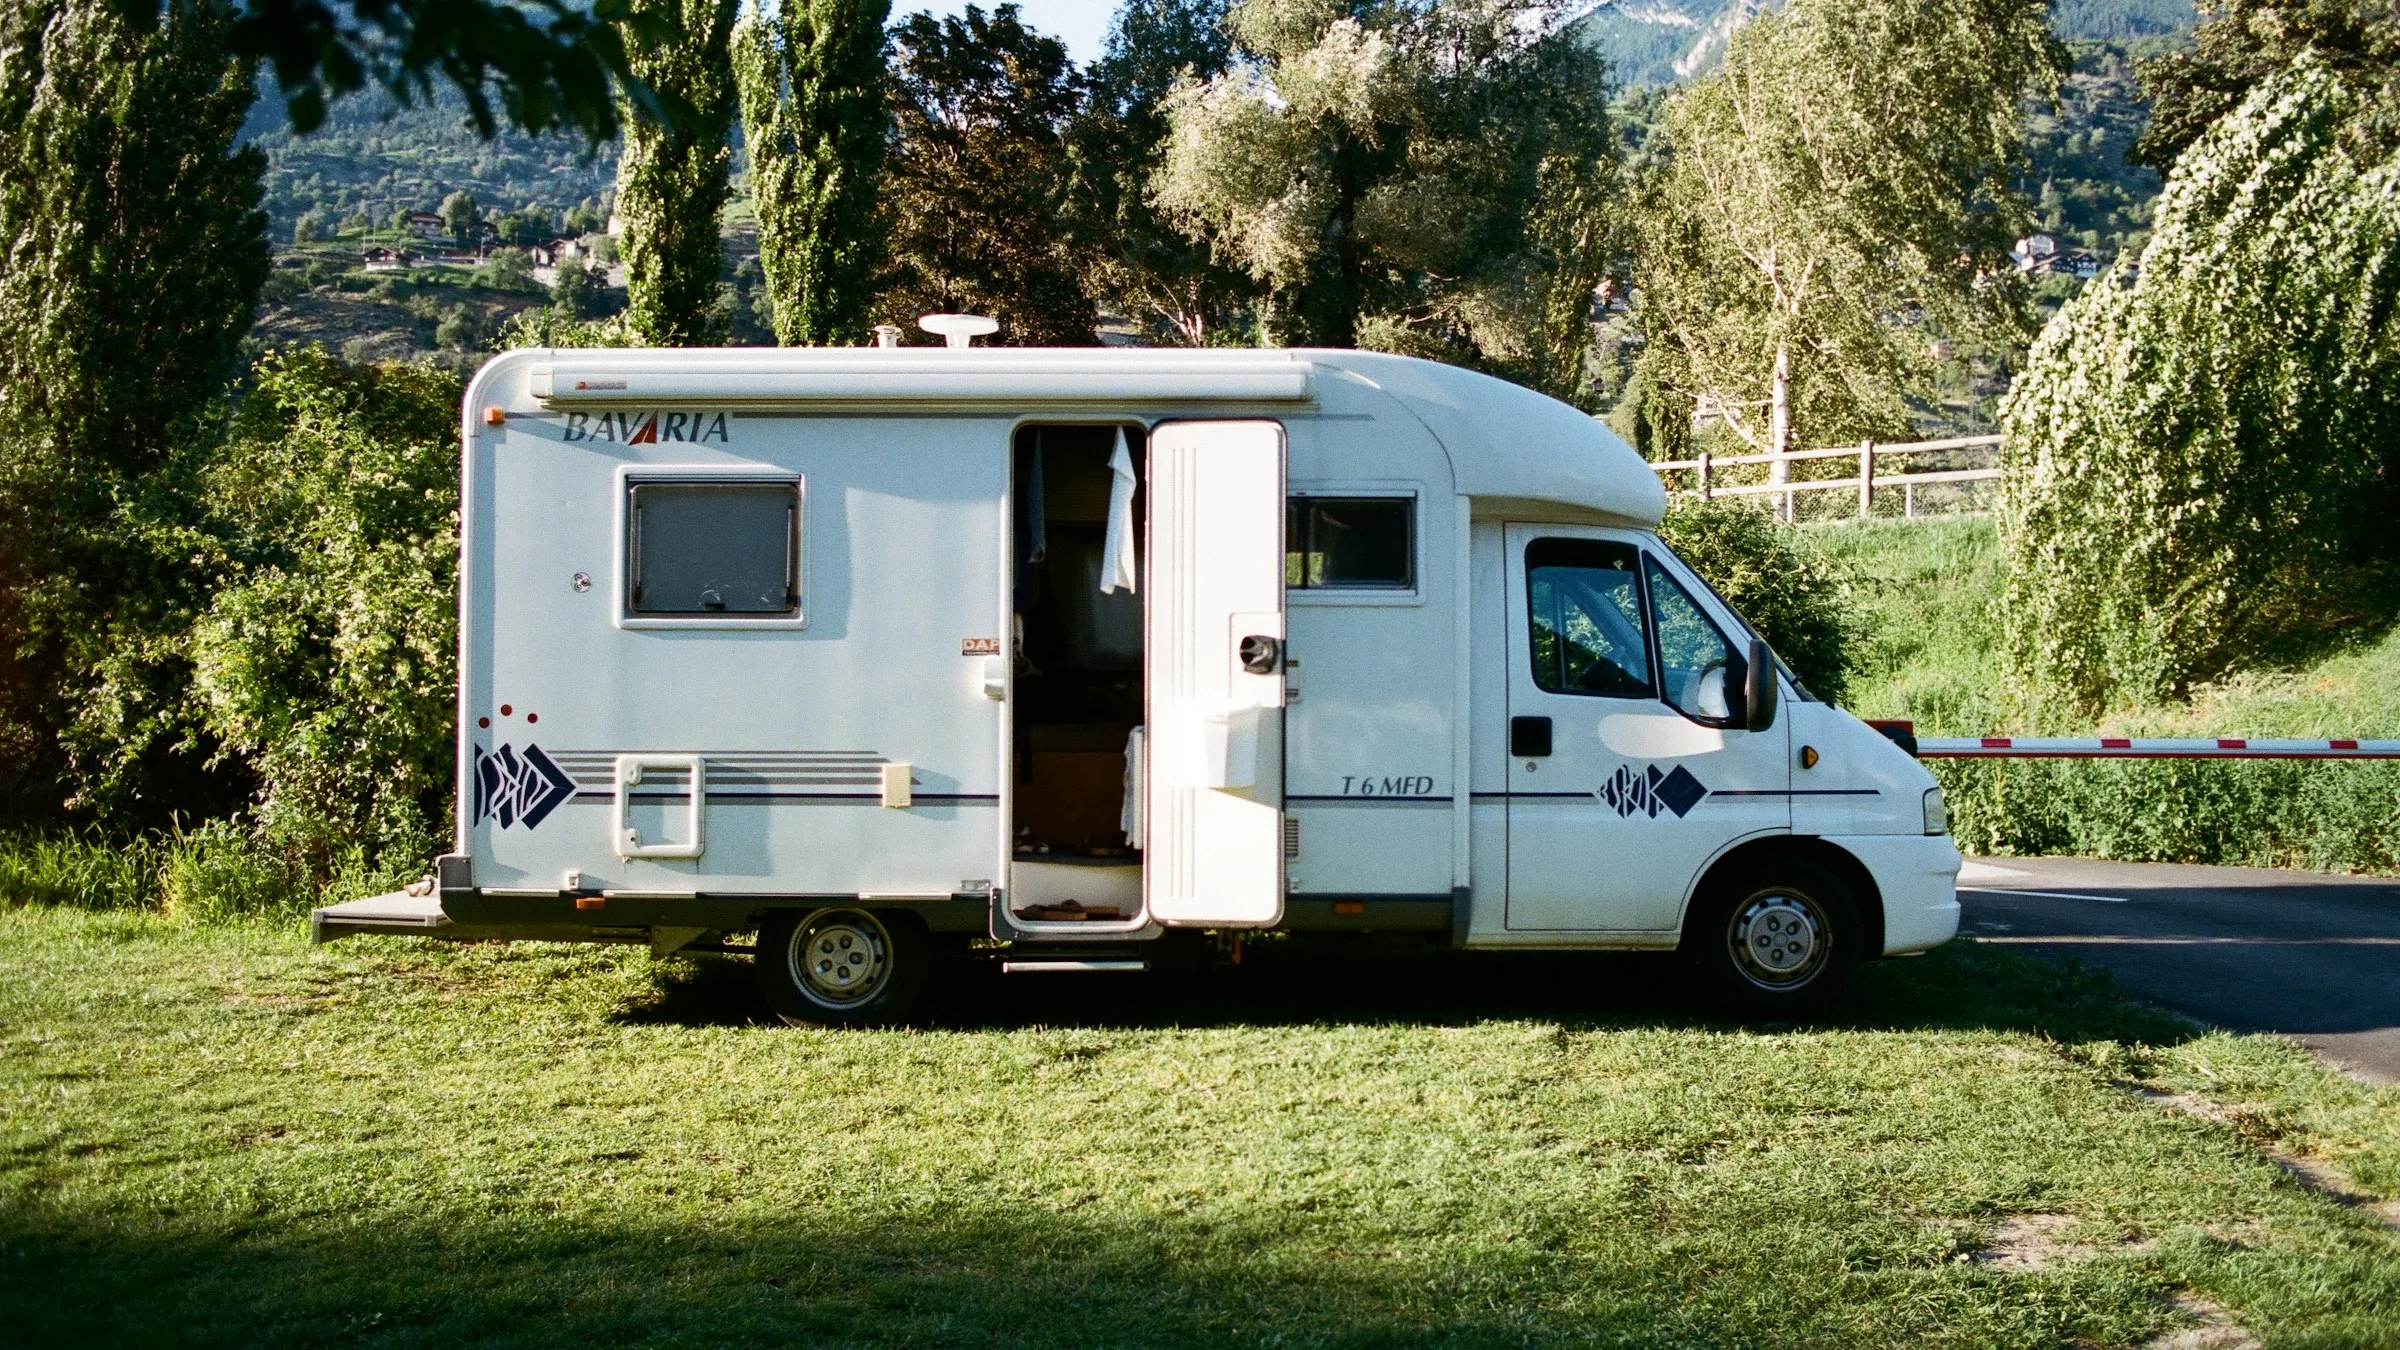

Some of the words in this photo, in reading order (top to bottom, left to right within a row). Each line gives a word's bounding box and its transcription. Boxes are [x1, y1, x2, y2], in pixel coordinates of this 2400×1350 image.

[563, 410, 729, 445] BAVARIA
[1341, 776, 1356, 795] T
[1361, 776, 1374, 795] 6
[1380, 776, 1433, 795] MFD
